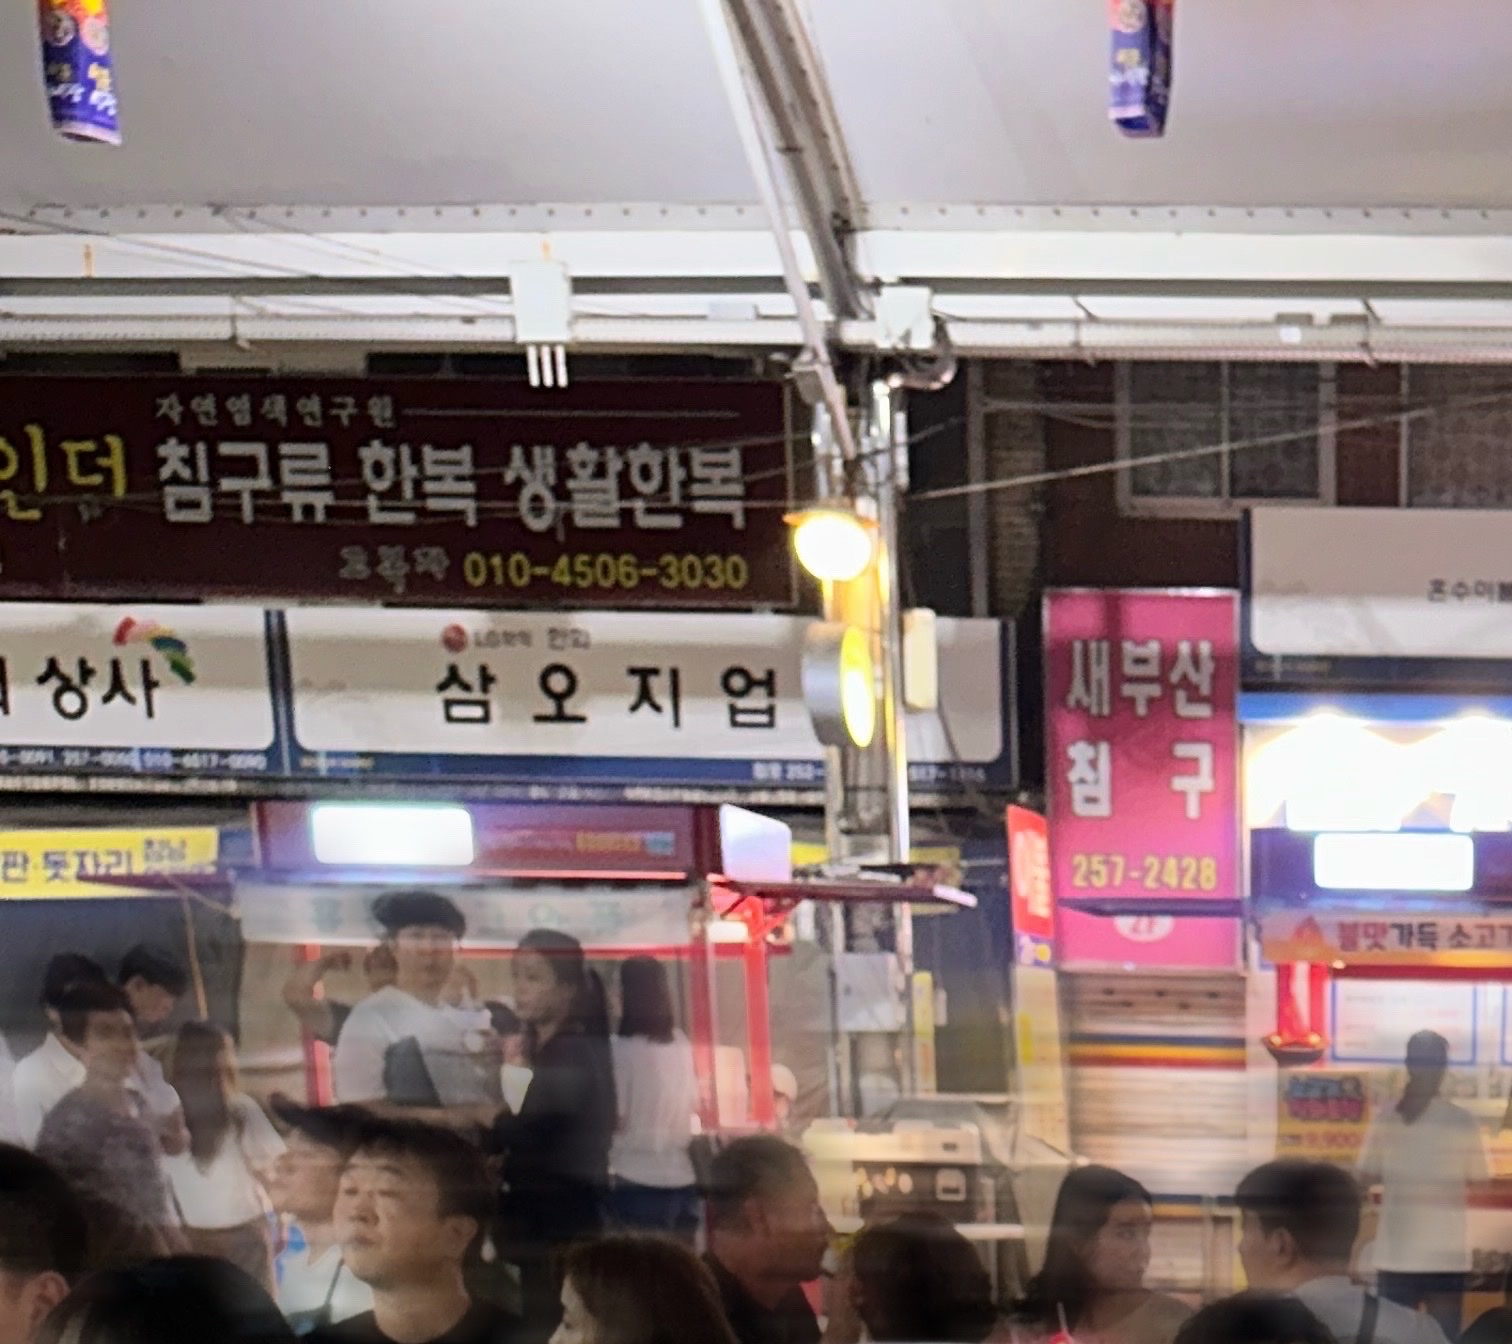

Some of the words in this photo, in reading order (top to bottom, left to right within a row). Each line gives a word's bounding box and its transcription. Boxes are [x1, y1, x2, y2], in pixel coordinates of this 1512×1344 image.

[156, 436, 335, 524] 침구류
[358, 440, 477, 527] 한복
[503, 443, 747, 532] 생활한복
[464, 553, 748, 589] 010-4506-3030
[36, 656, 160, 720] 상사
[436, 663, 777, 728] 삼오지업
[1066, 637, 1215, 717] 새부산
[1066, 742, 1216, 819] 침구
[1071, 853, 1218, 890] 257-2428
[1336, 920, 1441, 953] 불맛가득
